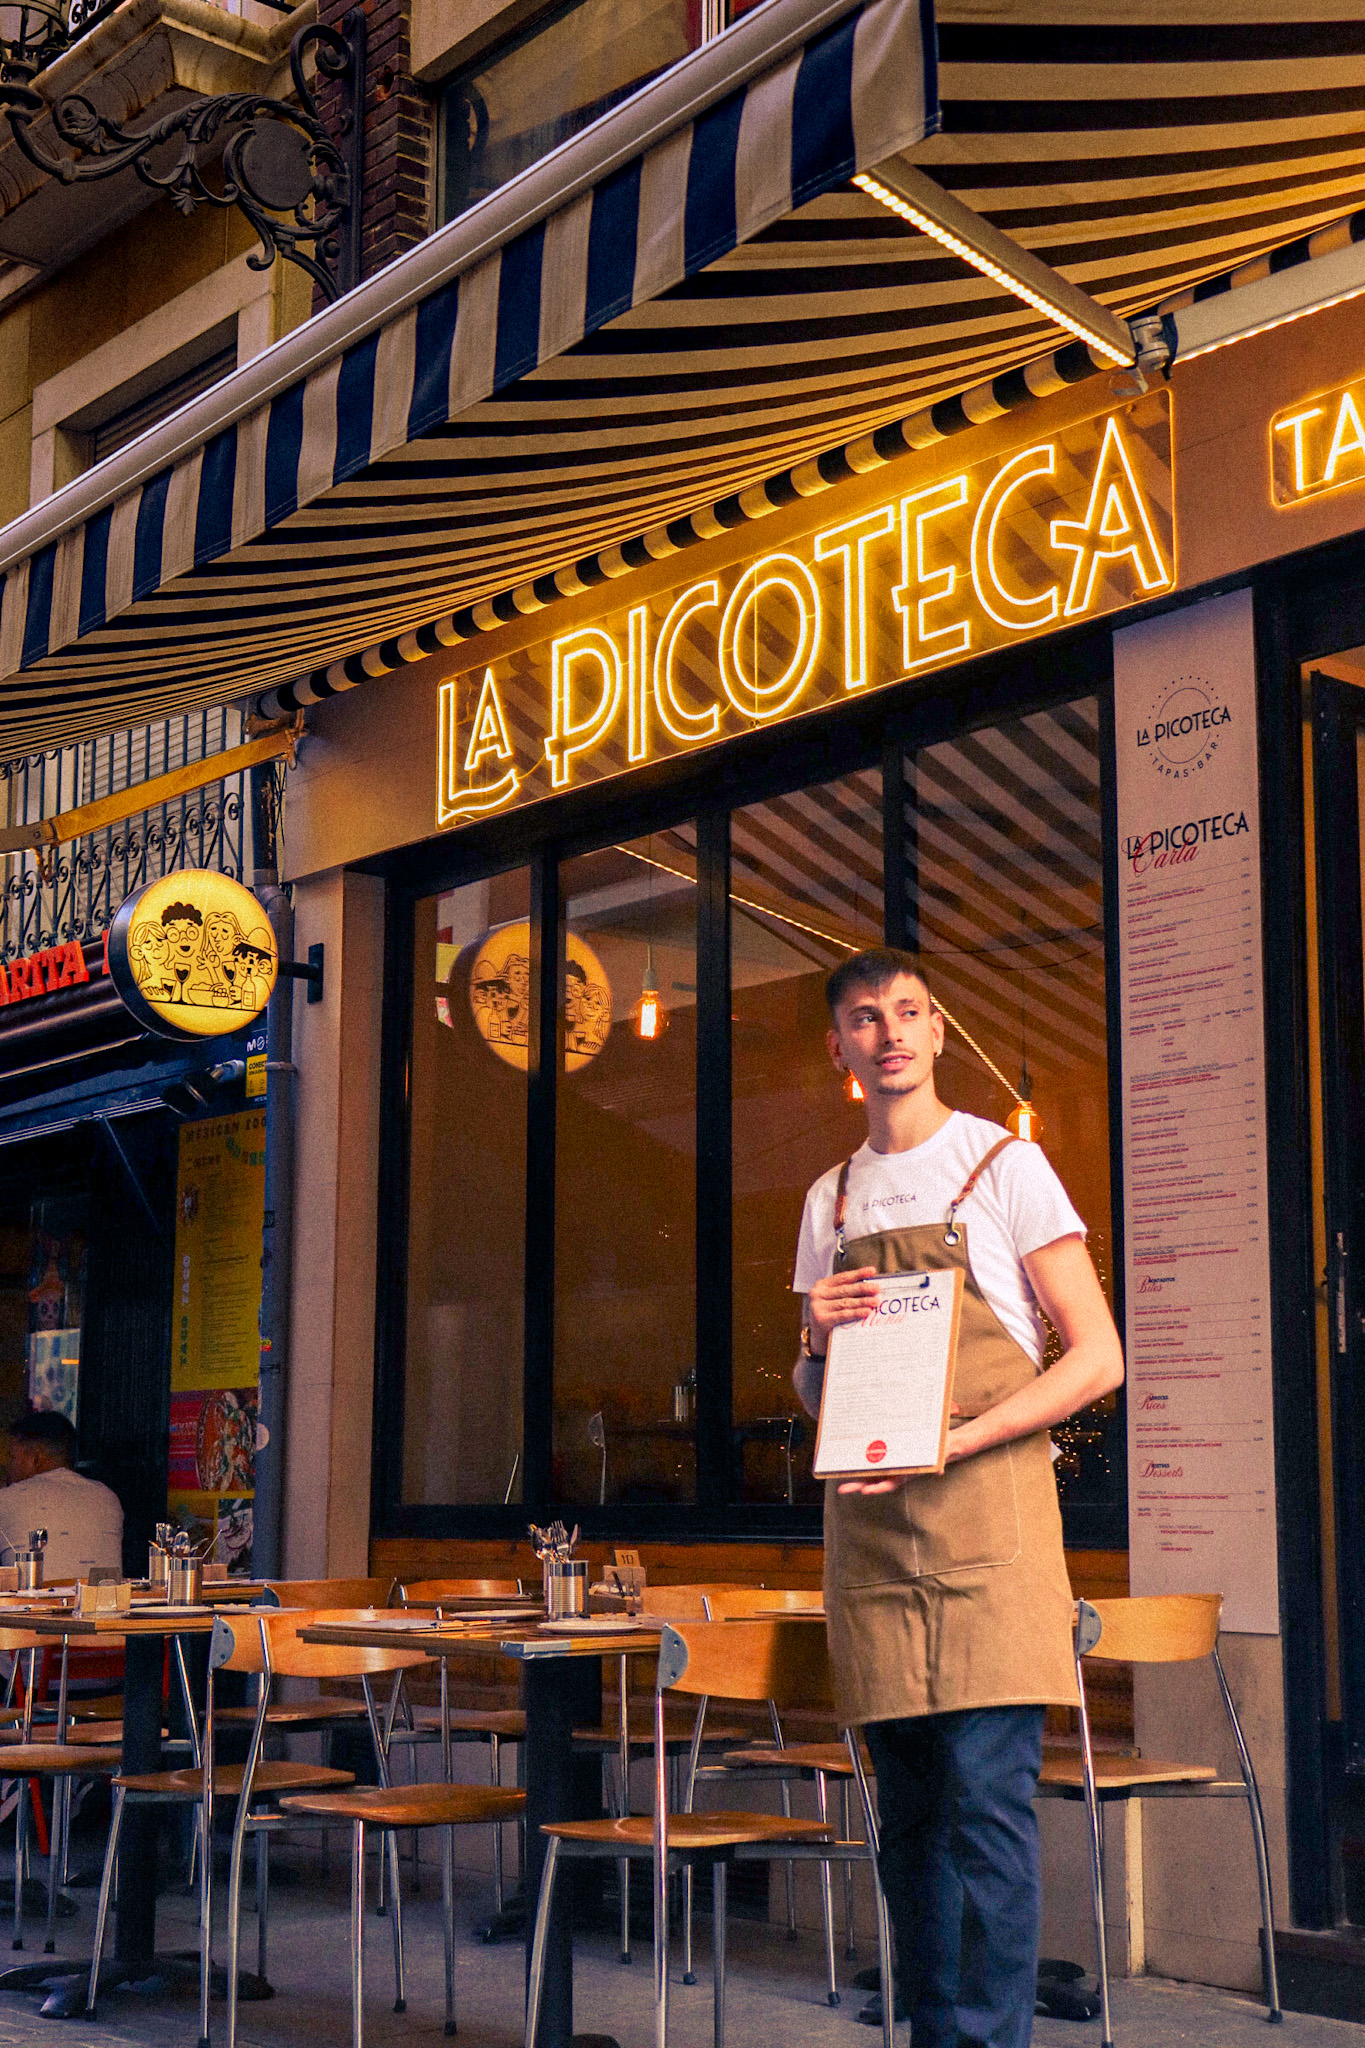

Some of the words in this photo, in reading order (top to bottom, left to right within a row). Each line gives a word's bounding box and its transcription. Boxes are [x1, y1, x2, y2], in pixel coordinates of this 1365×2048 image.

[436, 667, 520, 828] LA
[544, 415, 1169, 790] PICOTECA
[1137, 728, 1150, 747] LA
[1155, 705, 1231, 741] PICOTECA
[1151, 756, 1189, 779] TAPAS
[1197, 741, 1219, 769] BAR
[1127, 837, 1147, 861] LA
[1150, 811, 1249, 855] PICOTECA
[871, 1194, 917, 1208] PICOTECA
[872, 1295, 940, 1315] COTECA
